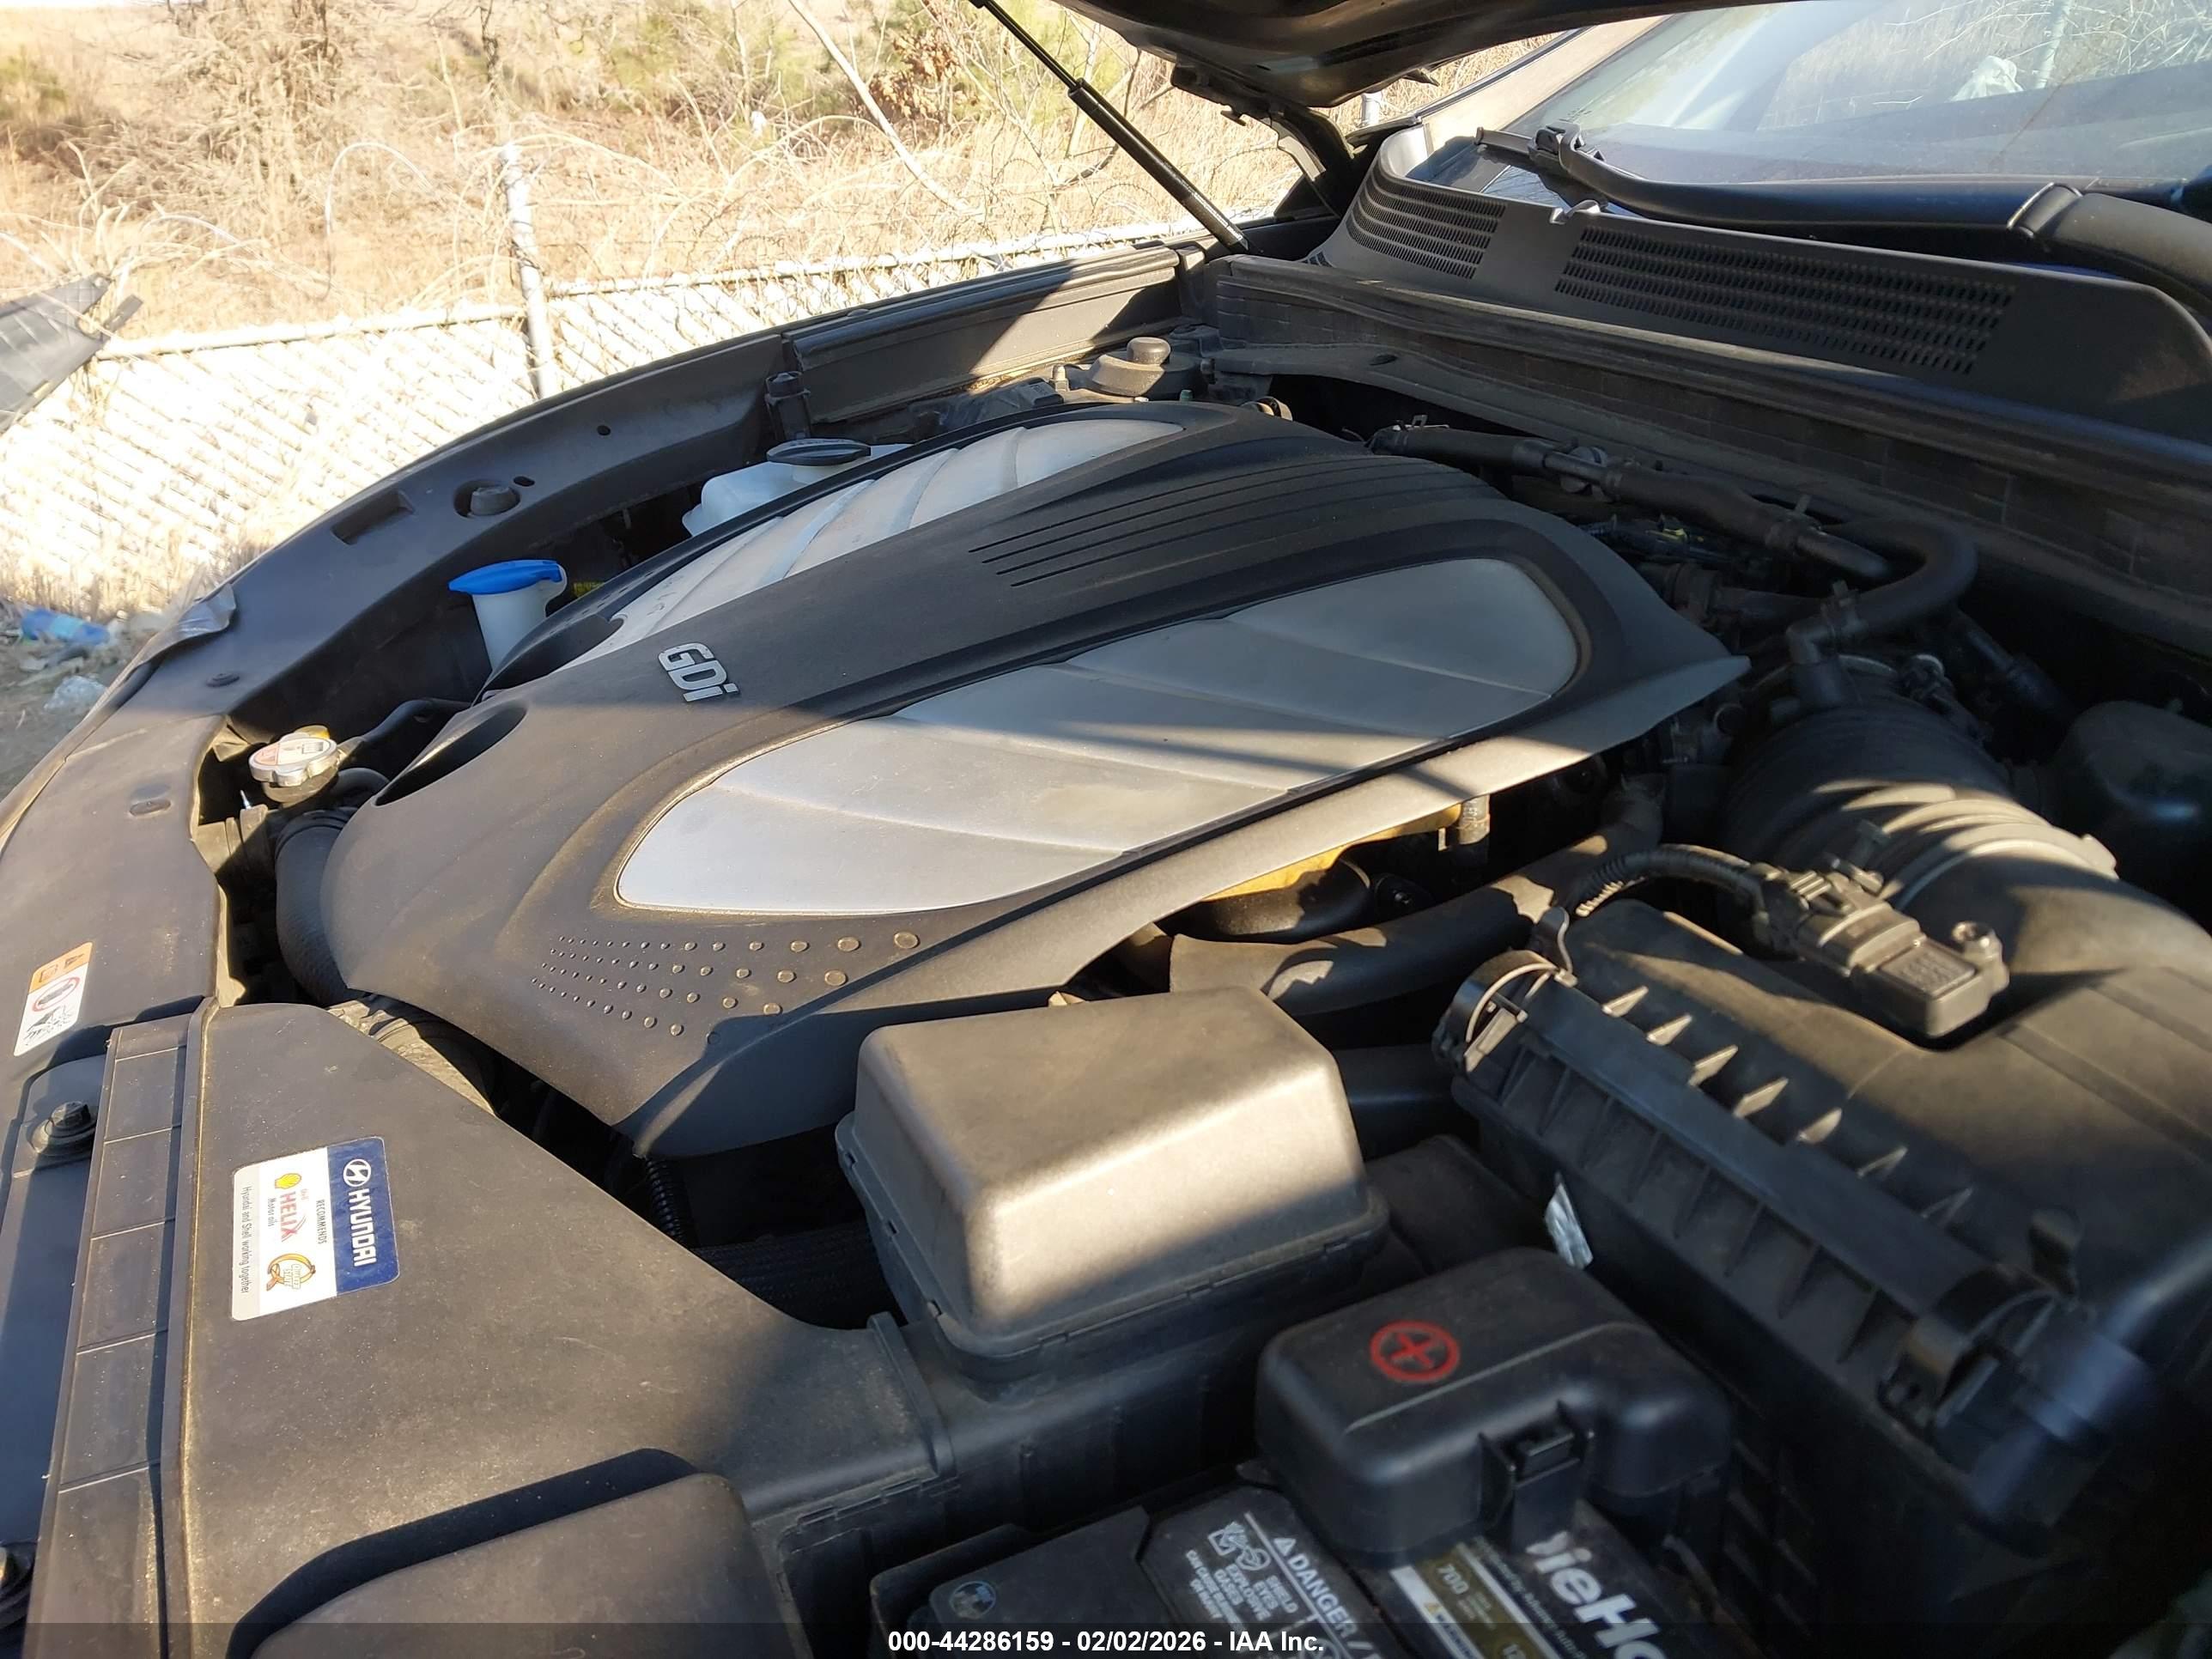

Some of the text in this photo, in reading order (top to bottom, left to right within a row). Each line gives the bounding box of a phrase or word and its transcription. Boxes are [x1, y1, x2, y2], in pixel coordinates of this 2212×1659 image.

[658, 642, 739, 702] GDi
[267, 1198, 278, 1227] Motor oils
[280, 1191, 299, 1242] HELIX
[316, 1199, 328, 1244] RECOMMENDS
[349, 1188, 377, 1267] HYUNDAI
[239, 1186, 253, 1293] Hyundai and Shell working together
[1212, 1569, 1244, 1606] GASES
[1224, 1563, 1273, 1621] EXPLOSIVE
[1253, 1580, 1279, 1611] EYES
[1266, 1575, 1299, 1614] SHIELD
[1288, 1553, 1358, 1638] DANGER
[1437, 1563, 1469, 1595] 700
